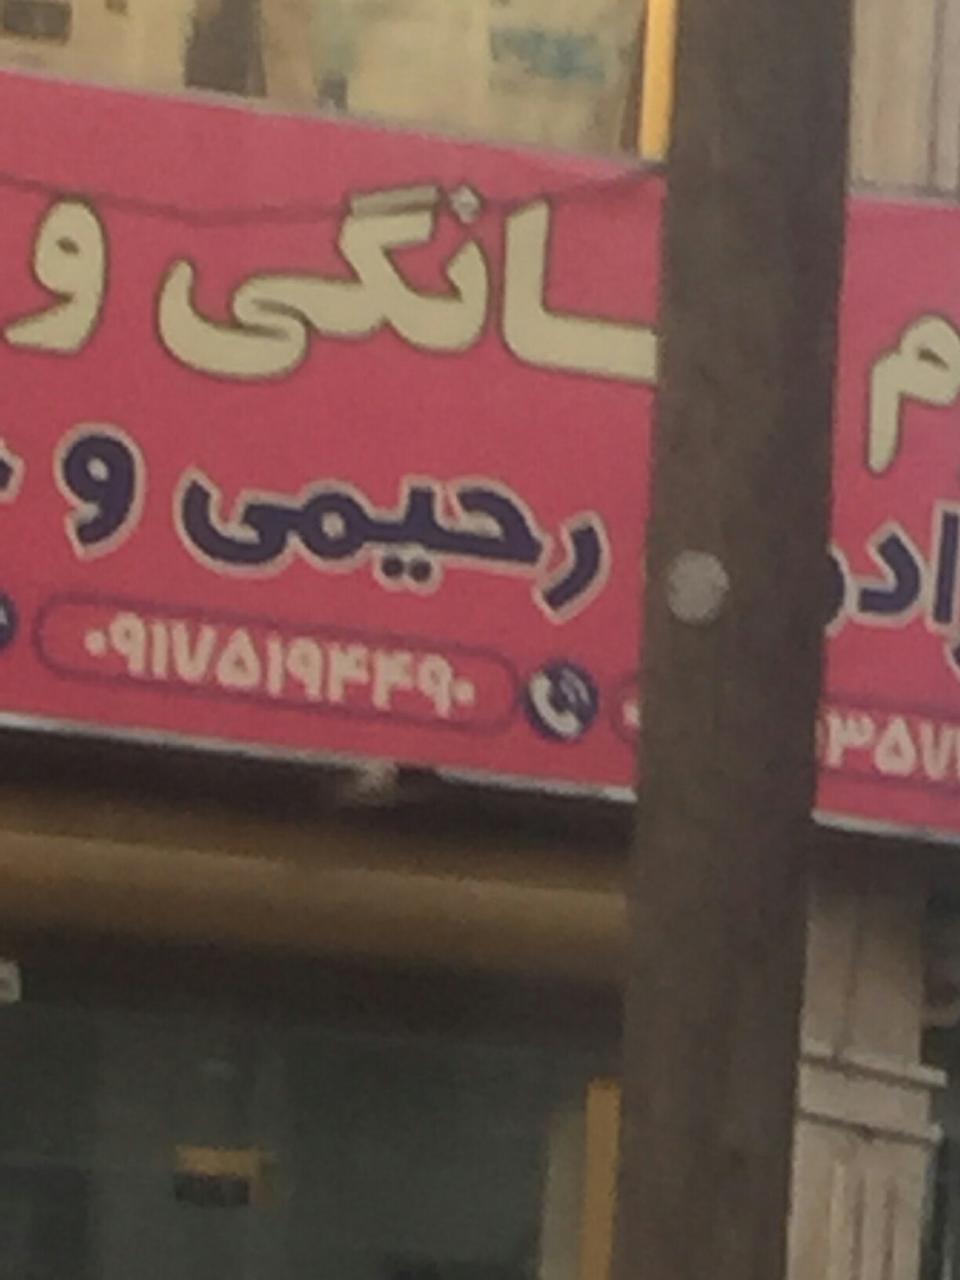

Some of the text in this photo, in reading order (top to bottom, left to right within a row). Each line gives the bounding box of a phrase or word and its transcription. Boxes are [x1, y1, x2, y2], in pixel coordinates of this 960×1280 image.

[3, 199, 108, 354] و
[156, 184, 660, 384] انگی
[54, 421, 146, 562] و
[172, 470, 608, 623] رحیمی
